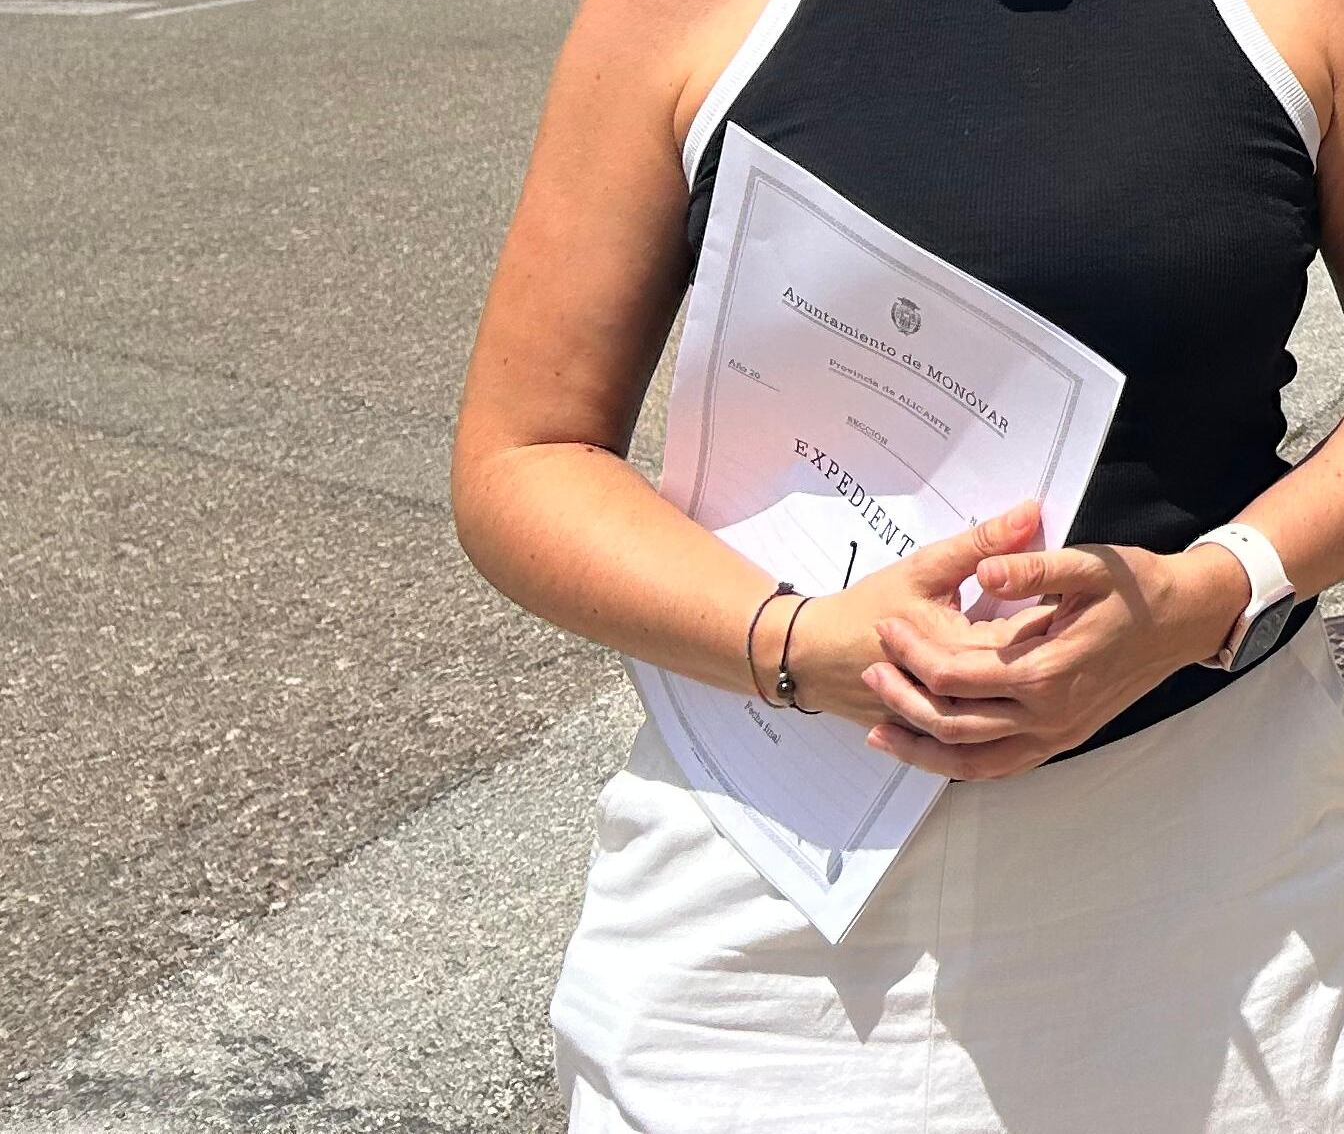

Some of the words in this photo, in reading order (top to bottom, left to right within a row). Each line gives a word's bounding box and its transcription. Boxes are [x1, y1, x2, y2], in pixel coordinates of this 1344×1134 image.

[783, 287, 897, 357] Ayuntamiento
[902, 353, 922, 370] de
[928, 364, 1010, 434] MONÓVAR
[829, 358, 879, 388] Provincia
[882, 384, 896, 396] de
[898, 394, 952, 435] ALICANTE
[794, 438, 922, 557] EXPEDIENT
